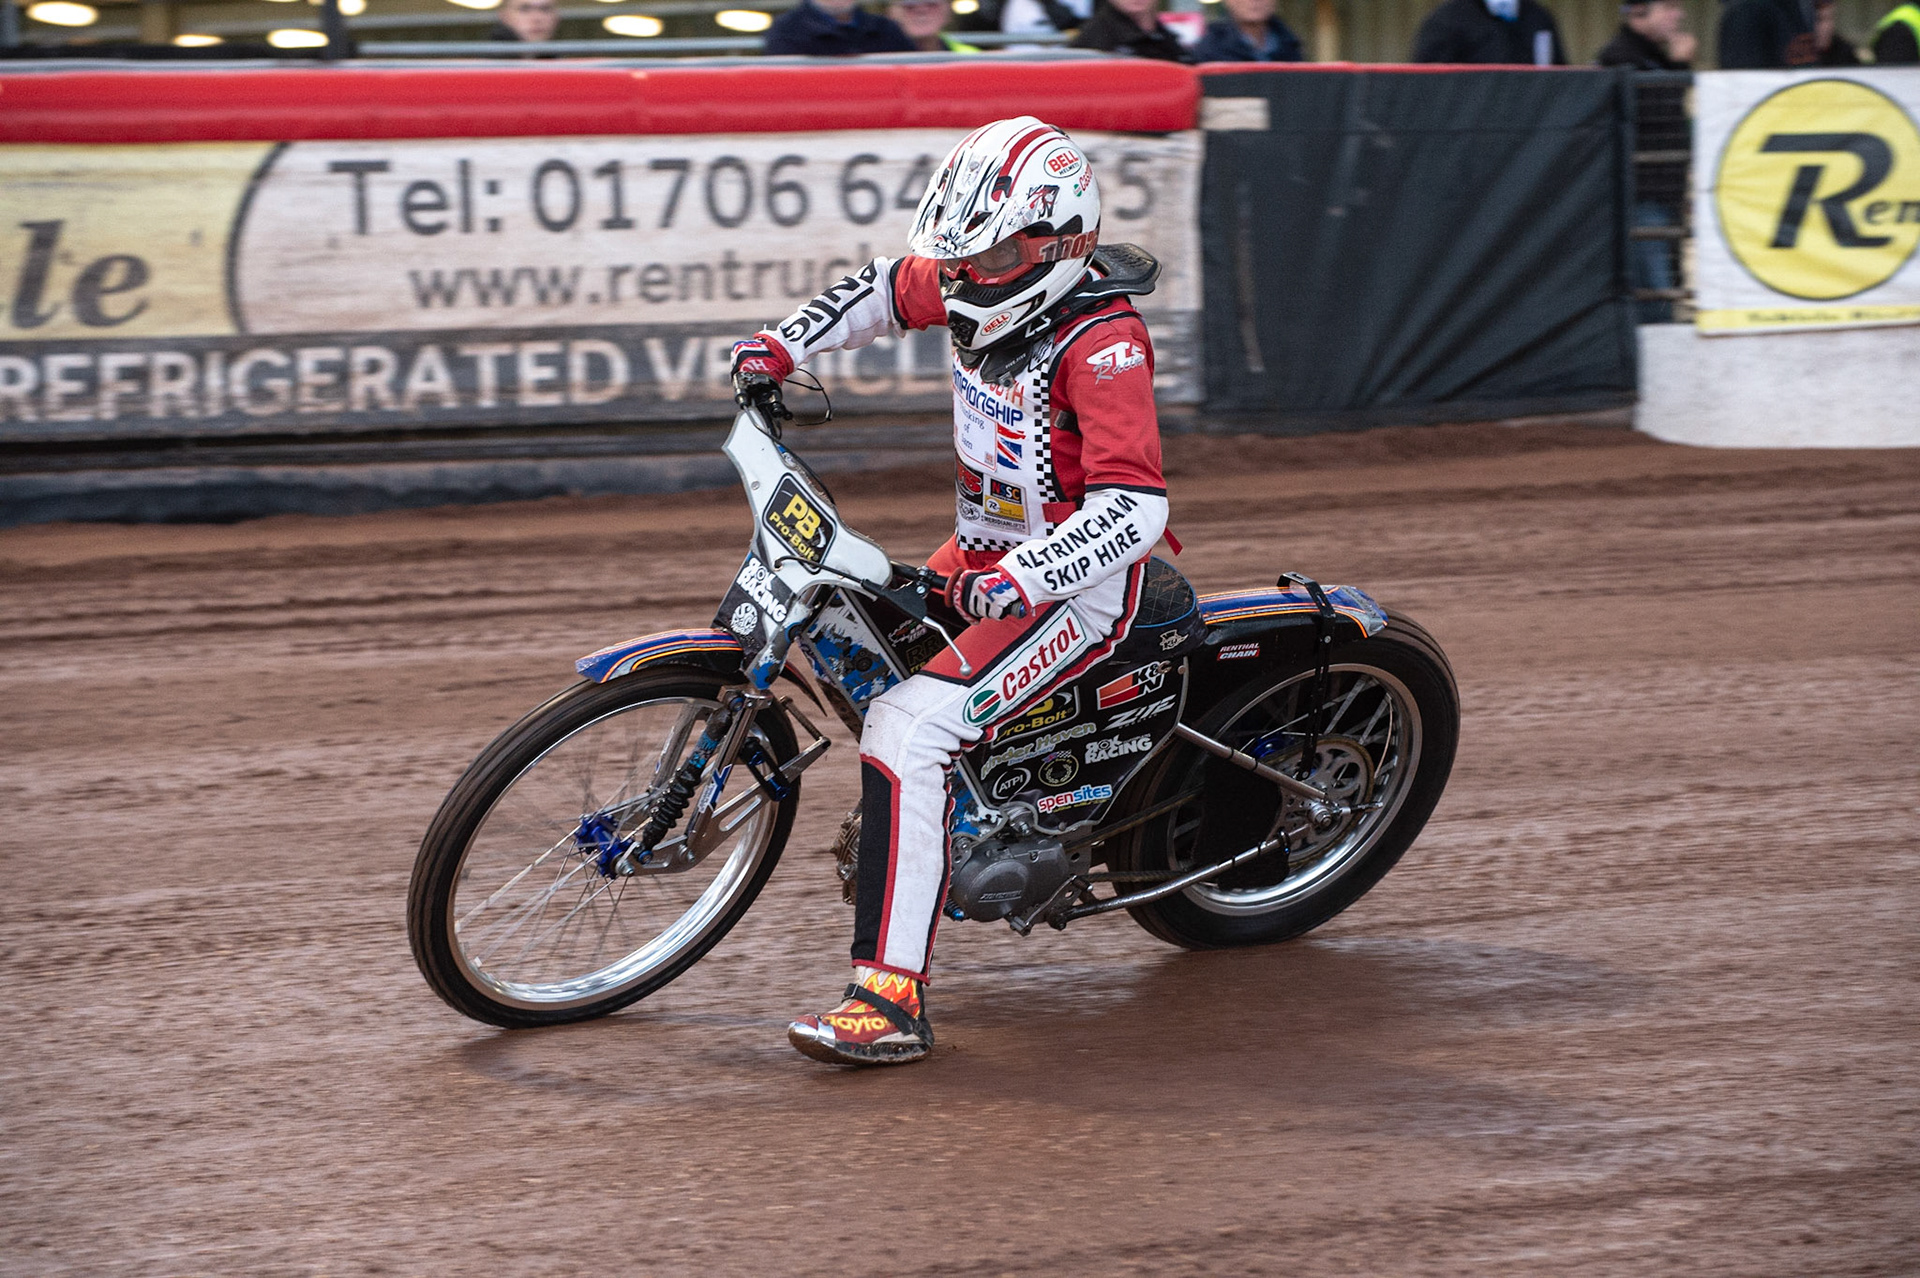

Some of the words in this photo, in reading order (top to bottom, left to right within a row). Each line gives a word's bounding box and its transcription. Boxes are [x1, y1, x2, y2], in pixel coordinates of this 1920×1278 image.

[1048, 150, 1079, 172] BELL
[329, 159, 501, 236] Tel:
[531, 153, 809, 233] 01706
[983, 314, 1009, 333] BELL
[0, 339, 630, 422] REFRIGERATED
[991, 481, 1020, 501] NSSC
[783, 493, 821, 540] PB
[1016, 493, 1138, 569] ALTRINCHAM
[769, 511, 815, 561] Pro-Bolt
[1043, 556, 1091, 591] SKIP
[1094, 523, 1142, 567] HIRE
[736, 566, 787, 622] RACING
[1002, 617, 1080, 701] Castrol
[1220, 643, 1259, 652] RENTHAL
[1220, 650, 1256, 660] CHAIN
[1035, 722, 1097, 749] Haven
[1085, 738, 1153, 764] RACING
[998, 774, 1023, 794] ATPI
[1038, 784, 1112, 814] spensites
